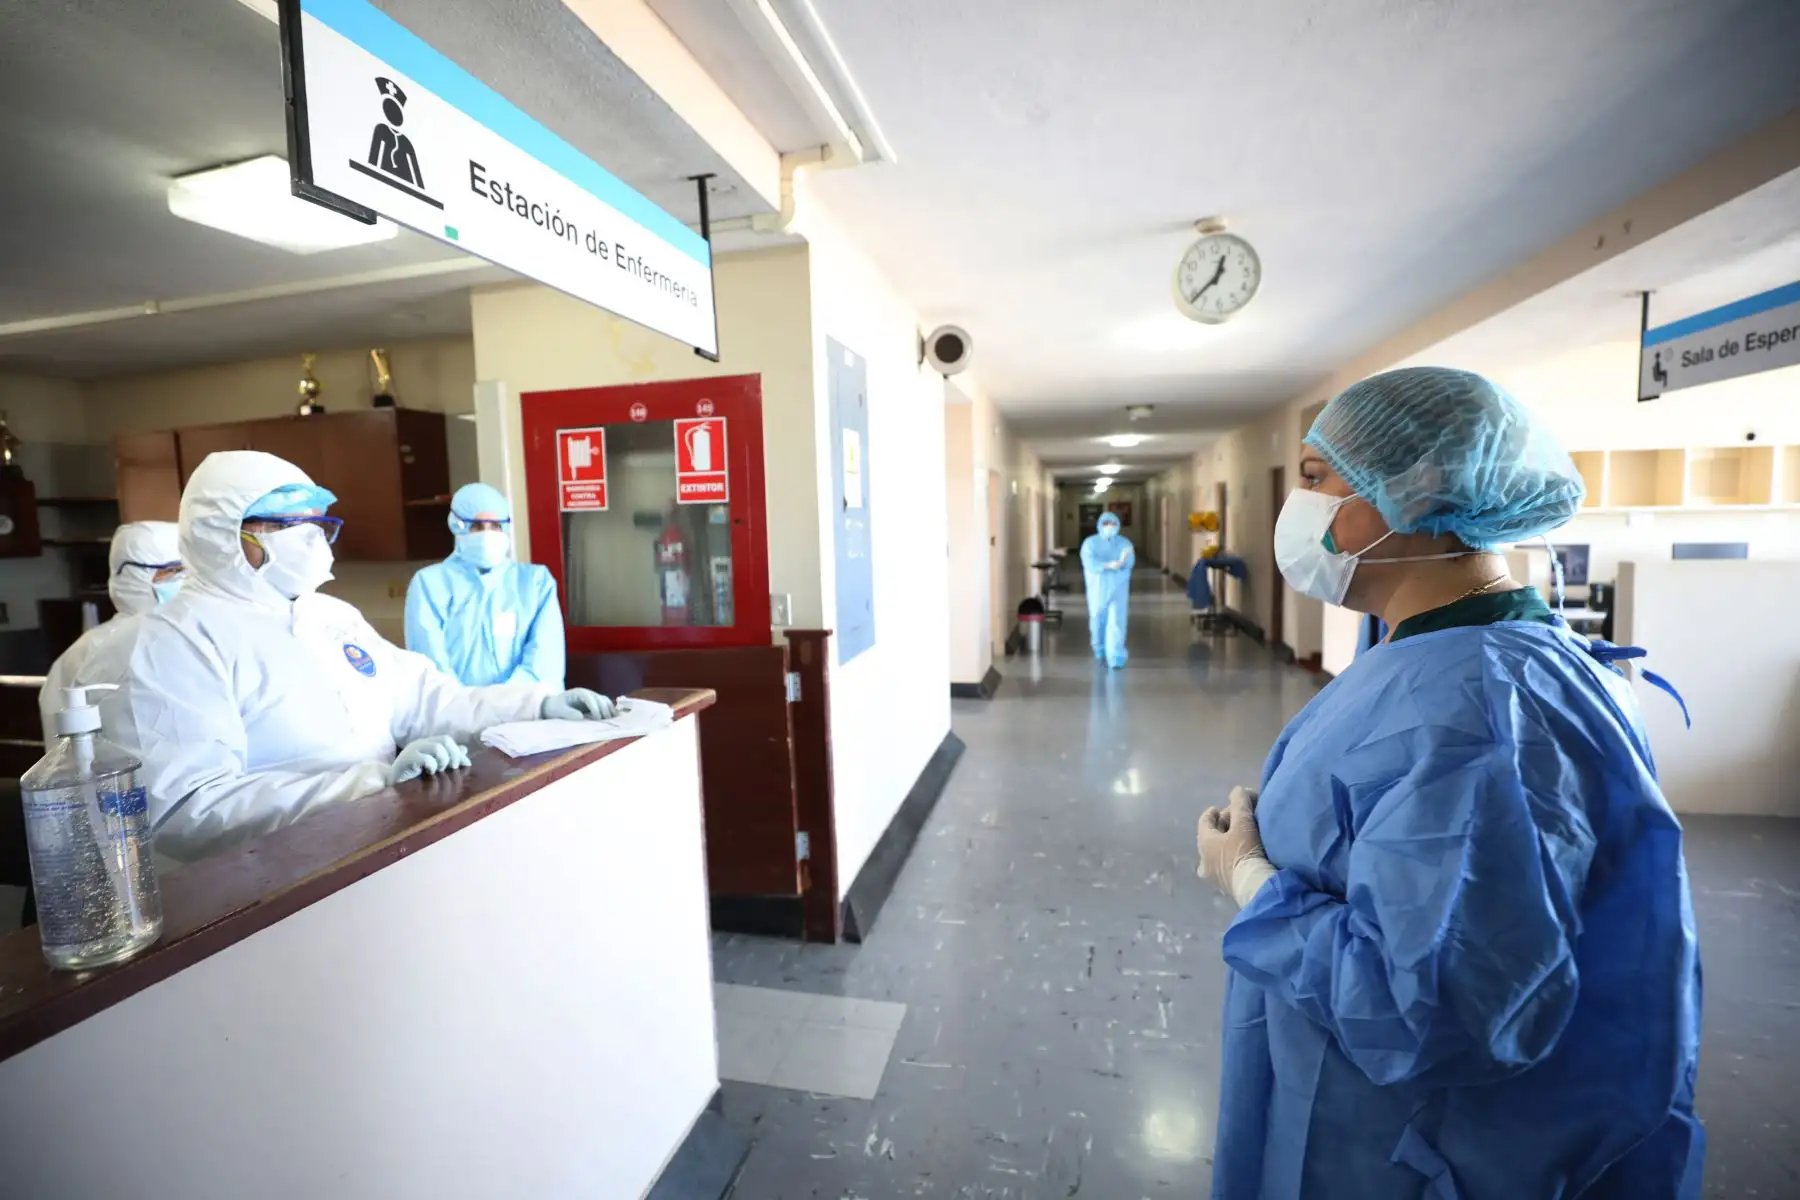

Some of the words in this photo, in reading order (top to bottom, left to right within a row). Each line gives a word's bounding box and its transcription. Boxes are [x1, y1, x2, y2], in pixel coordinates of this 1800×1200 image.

[469, 158, 578, 245] Estación
[586, 230, 609, 260] de
[1681, 346, 1714, 368] Sala
[1718, 338, 1740, 359] de
[1745, 324, 1800, 352] Esper
[680, 482, 725, 493] EXTINTOR
